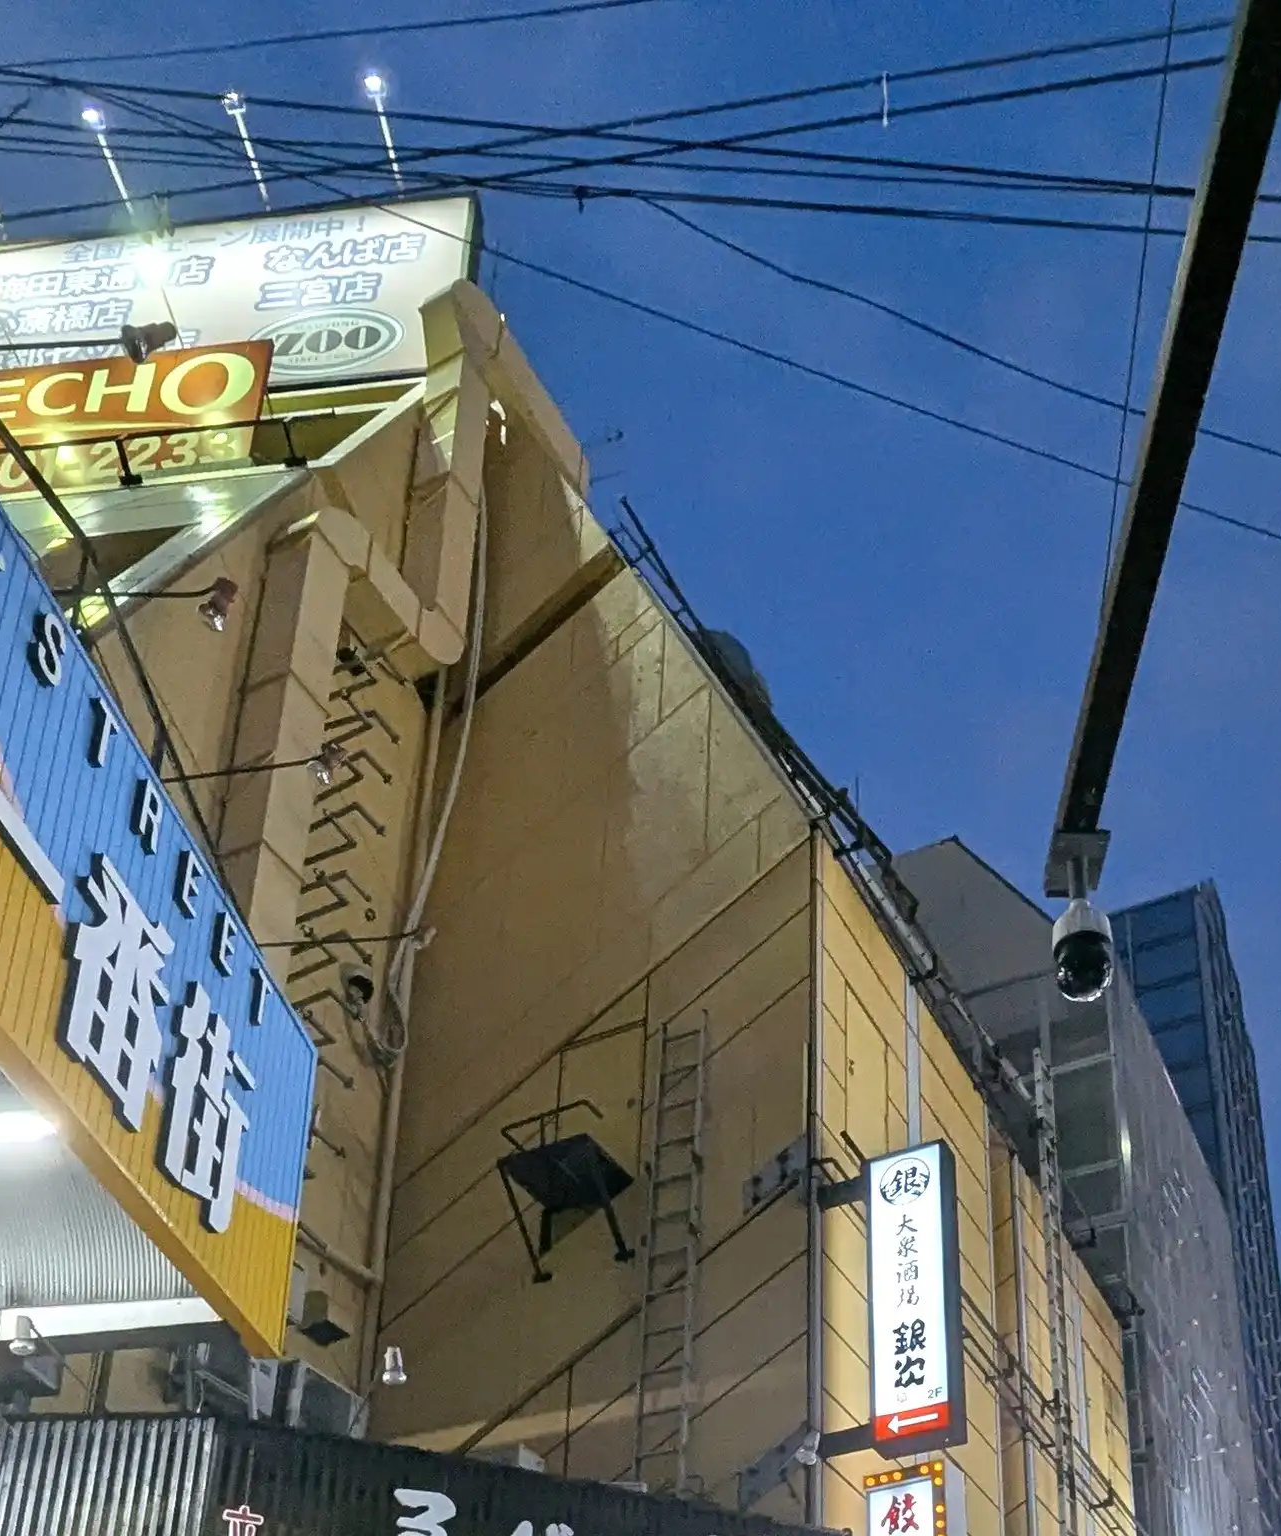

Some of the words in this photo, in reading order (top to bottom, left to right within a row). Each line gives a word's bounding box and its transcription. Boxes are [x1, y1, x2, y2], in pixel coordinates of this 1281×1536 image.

[264, 231, 426, 275] なんば店
[254, 271, 383, 311] 三宮店
[273, 325, 382, 356] ZOO
[927, 1386, 944, 1400] 2F
